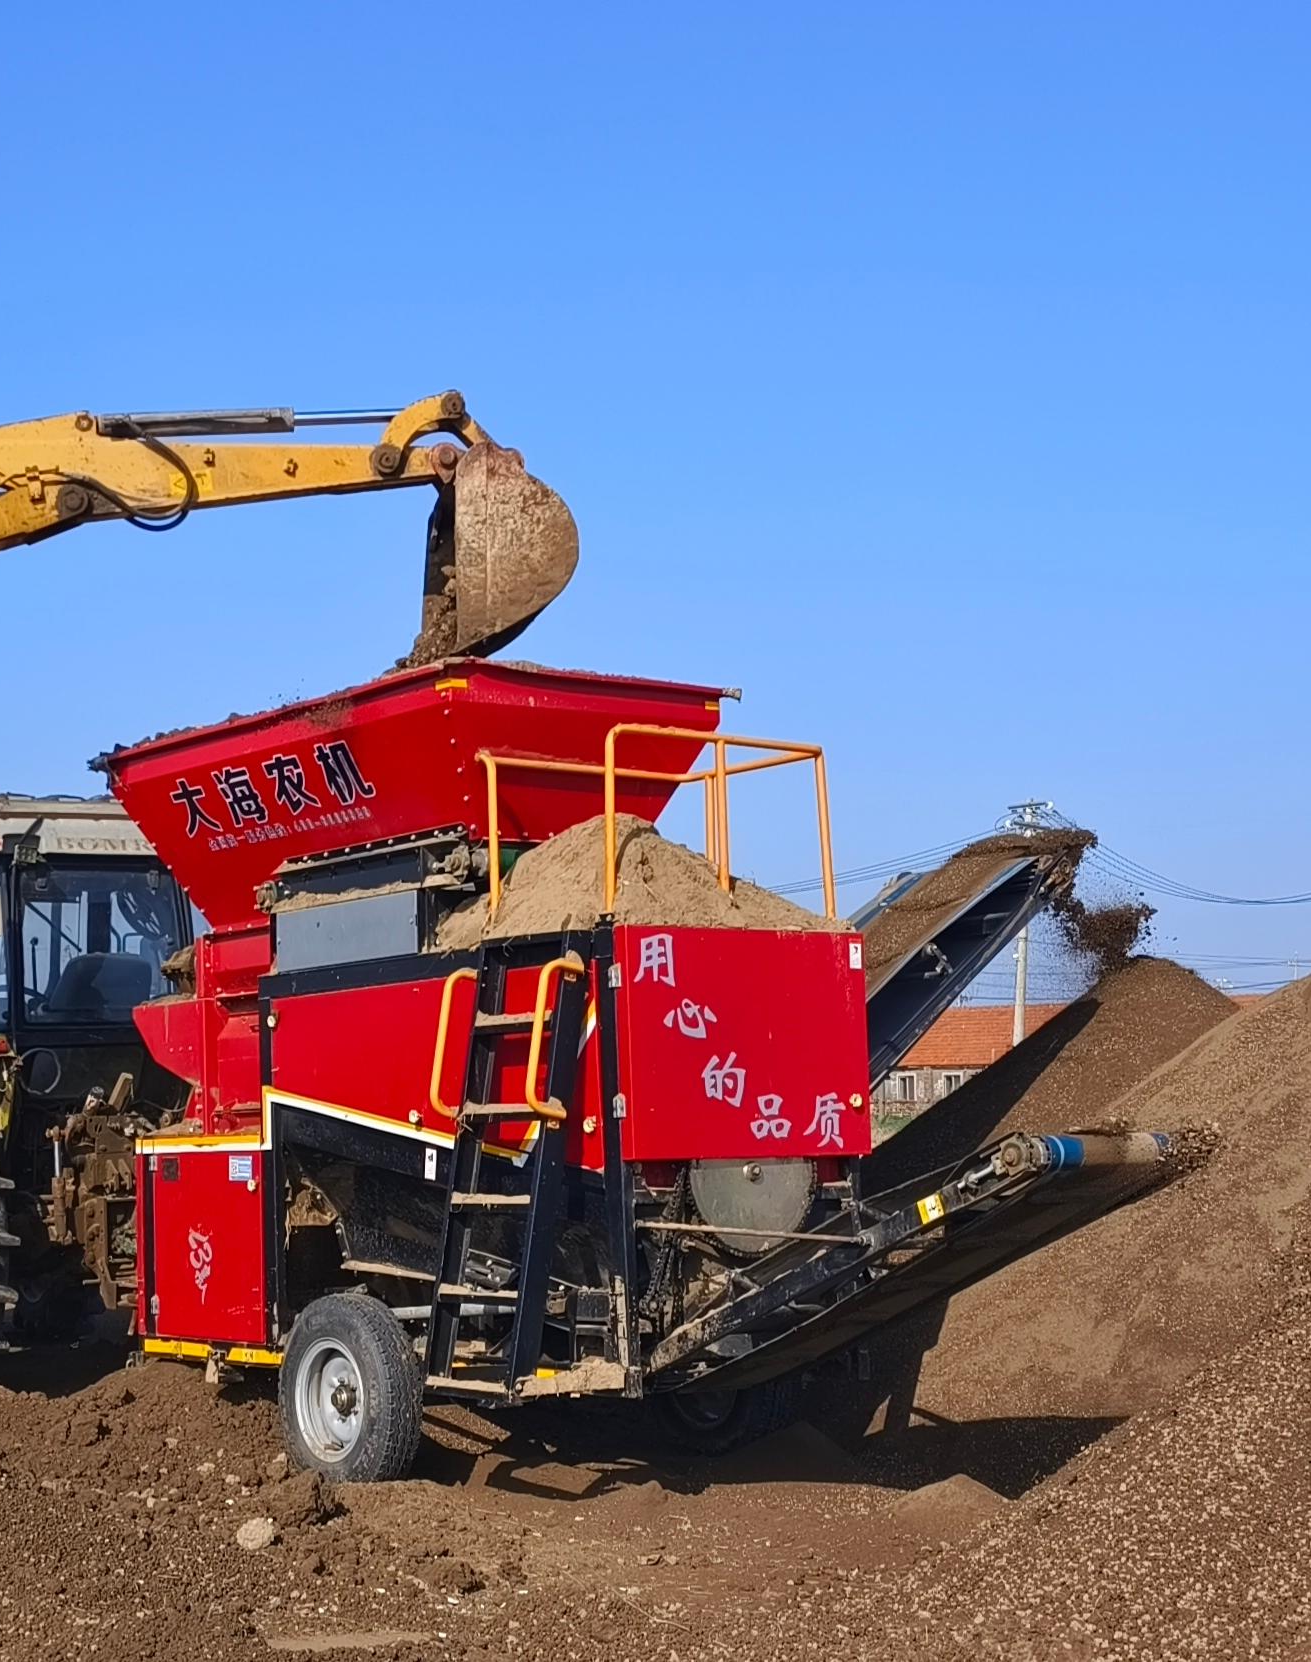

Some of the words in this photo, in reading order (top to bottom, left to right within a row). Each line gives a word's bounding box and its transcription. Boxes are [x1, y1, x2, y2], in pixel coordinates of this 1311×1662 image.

[169, 740, 376, 839] 大海农机
[633, 933, 847, 1149] 用心的品质
